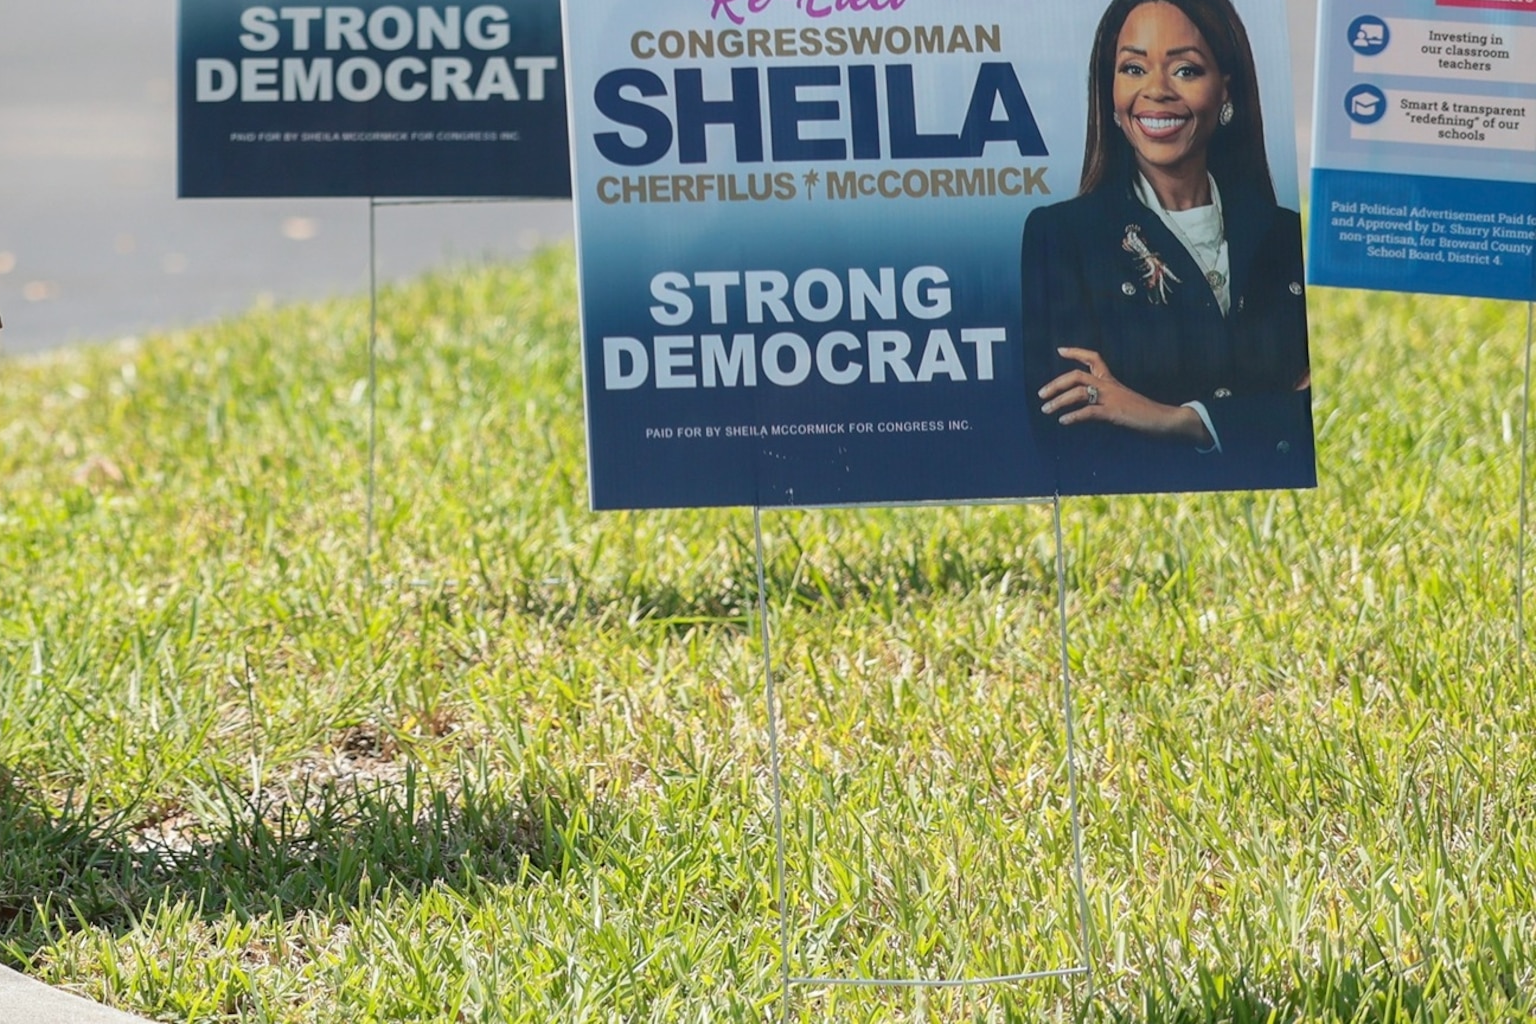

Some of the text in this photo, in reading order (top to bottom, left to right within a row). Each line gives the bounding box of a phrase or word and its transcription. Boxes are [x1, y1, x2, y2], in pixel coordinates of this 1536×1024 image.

[239, 6, 510, 51] STRONG
[1429, 30, 1503, 46] Investing in
[630, 24, 1001, 59] CONGRESSWOMAN
[1421, 44, 1510, 59] our classroom
[1438, 59, 1491, 71] teachers
[196, 57, 556, 103] DEMOCRAT
[592, 61, 1050, 167] SHEILA
[1400, 98, 1525, 117] Smart & transparent
[1438, 128, 1485, 141] schools
[1482, 118, 1495, 129] of
[1498, 120, 1519, 130] our
[230, 132, 256, 142] PAID
[258, 132, 281, 142] FOR
[283, 132, 298, 142] BY
[300, 132, 340, 142] SHEILA
[411, 132, 434, 142] FOR
[436, 132, 498, 142] CONGRESS
[596, 167, 1051, 205] CHERFILUS McCORMICK
[1331, 201, 1357, 213] Paid
[1360, 203, 1408, 217] Political
[1410, 207, 1495, 223] Advertisement
[1498, 213, 1524, 225] Paid
[1331, 216, 1536, 240] and Approved by Dr. Sharry Kimme
[1339, 230, 1533, 256] non-partisan, for Broward County
[1367, 245, 1503, 266] School Board, District 4.
[649, 265, 951, 326] STRONG
[602, 327, 1006, 391] DEMOCRAT
[646, 419, 973, 439] PAID FOR BY SHEILA MCCORMICK FOR CONGRESS INC.
